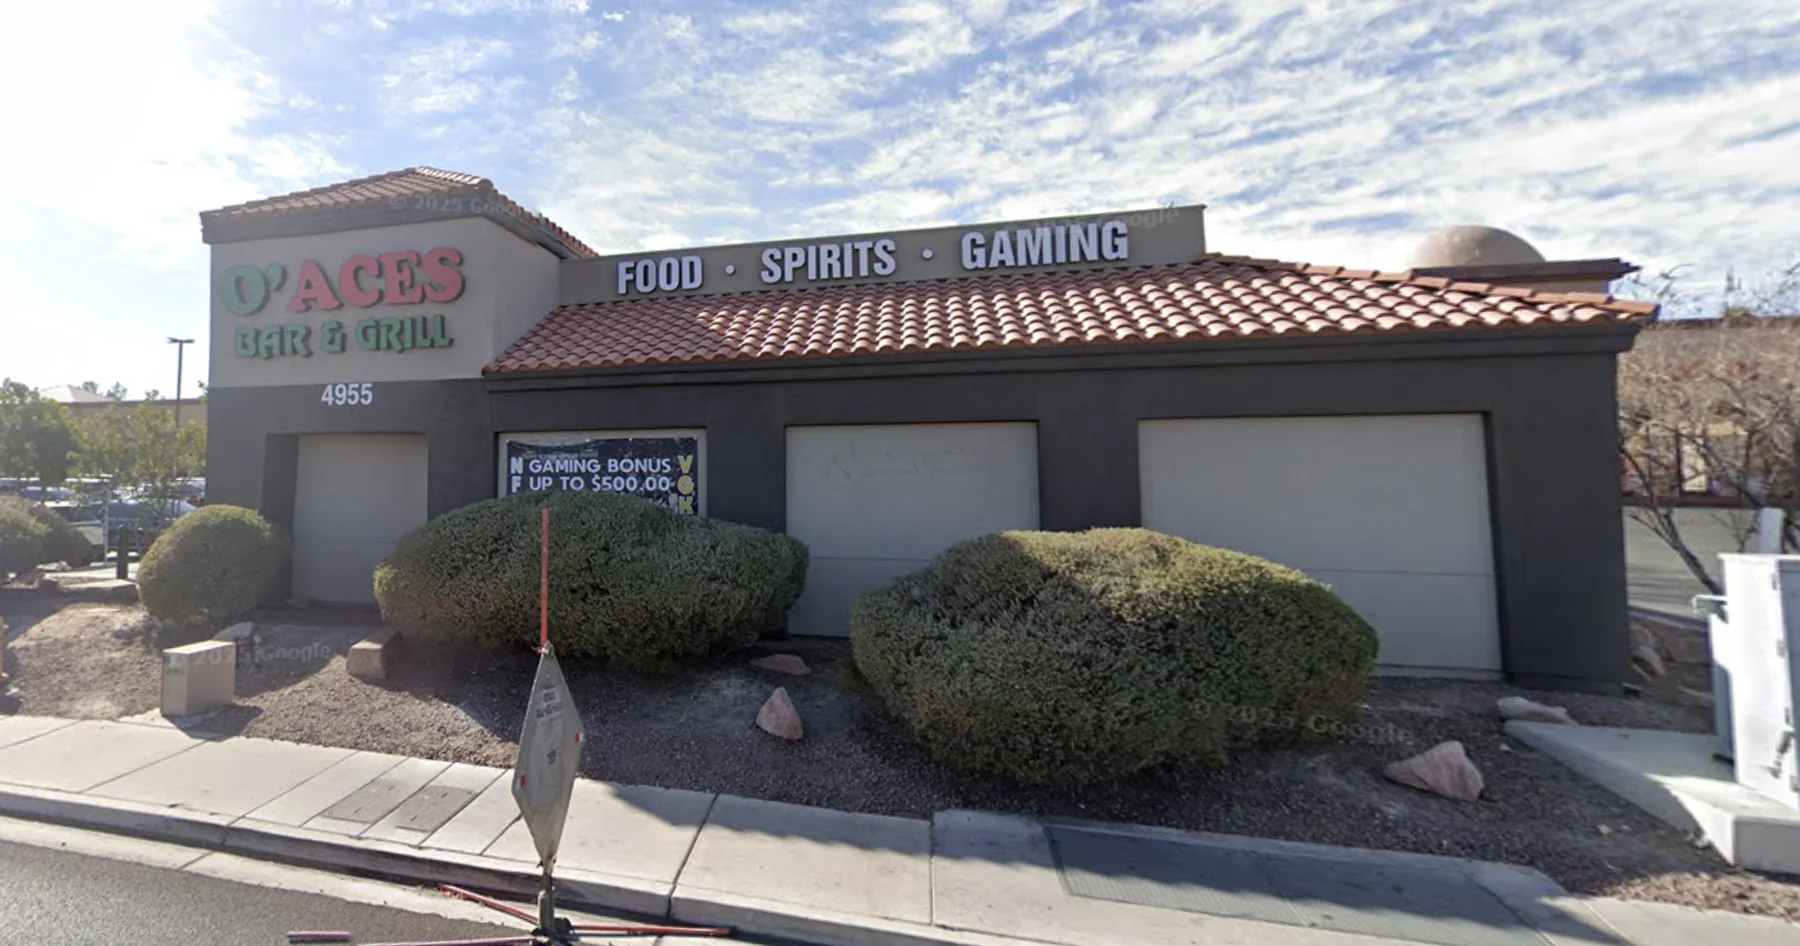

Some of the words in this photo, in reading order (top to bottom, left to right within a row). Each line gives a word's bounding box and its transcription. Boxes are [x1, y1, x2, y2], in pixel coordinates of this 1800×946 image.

[617, 255, 702, 294] FOOD
[760, 239, 896, 285] SPIRITS
[961, 220, 1130, 270] GAMING
[222, 248, 465, 315] O'ACES
[234, 322, 312, 358] BAR
[320, 321, 347, 354] &
[356, 315, 454, 353] GRILL
[322, 383, 373, 406] 4955
[529, 459, 601, 473] GAMING
[608, 458, 671, 473] BONUS
[529, 476, 553, 491] UP
[560, 476, 585, 491] TO
[592, 474, 671, 492] $500.00
